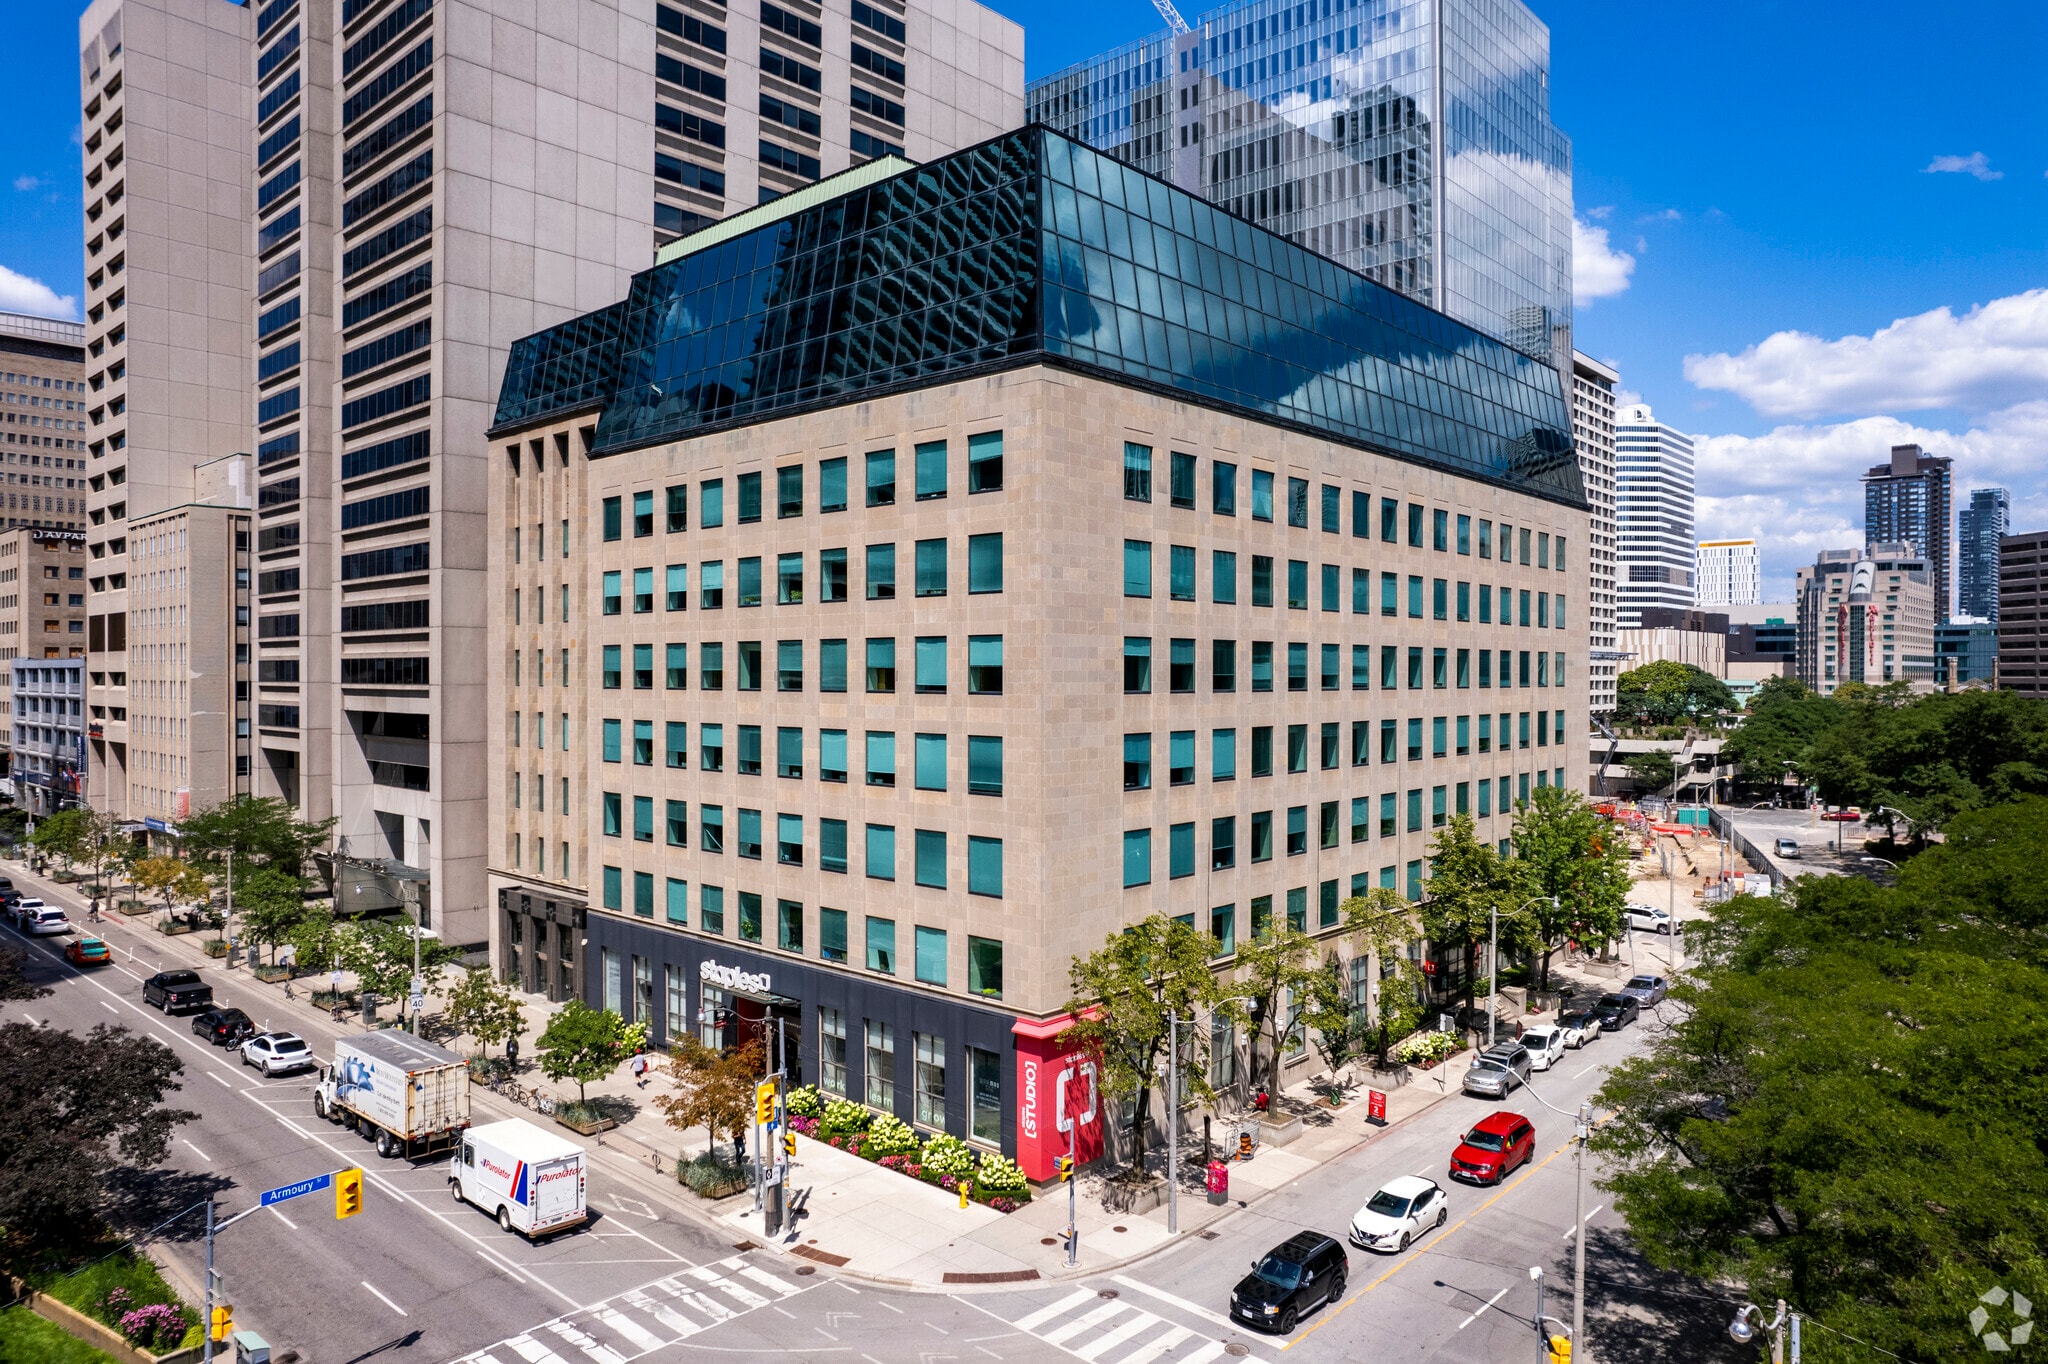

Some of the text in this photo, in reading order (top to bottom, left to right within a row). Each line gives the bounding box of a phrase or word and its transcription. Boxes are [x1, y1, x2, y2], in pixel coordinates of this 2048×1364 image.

[700, 959, 760, 993] staples
[823, 1076, 846, 1093] work
[868, 1089, 893, 1107] learn
[485, 1160, 511, 1180] Purolator
[539, 1166, 583, 1184] Purolator
[269, 1181, 314, 1201] Armoury
